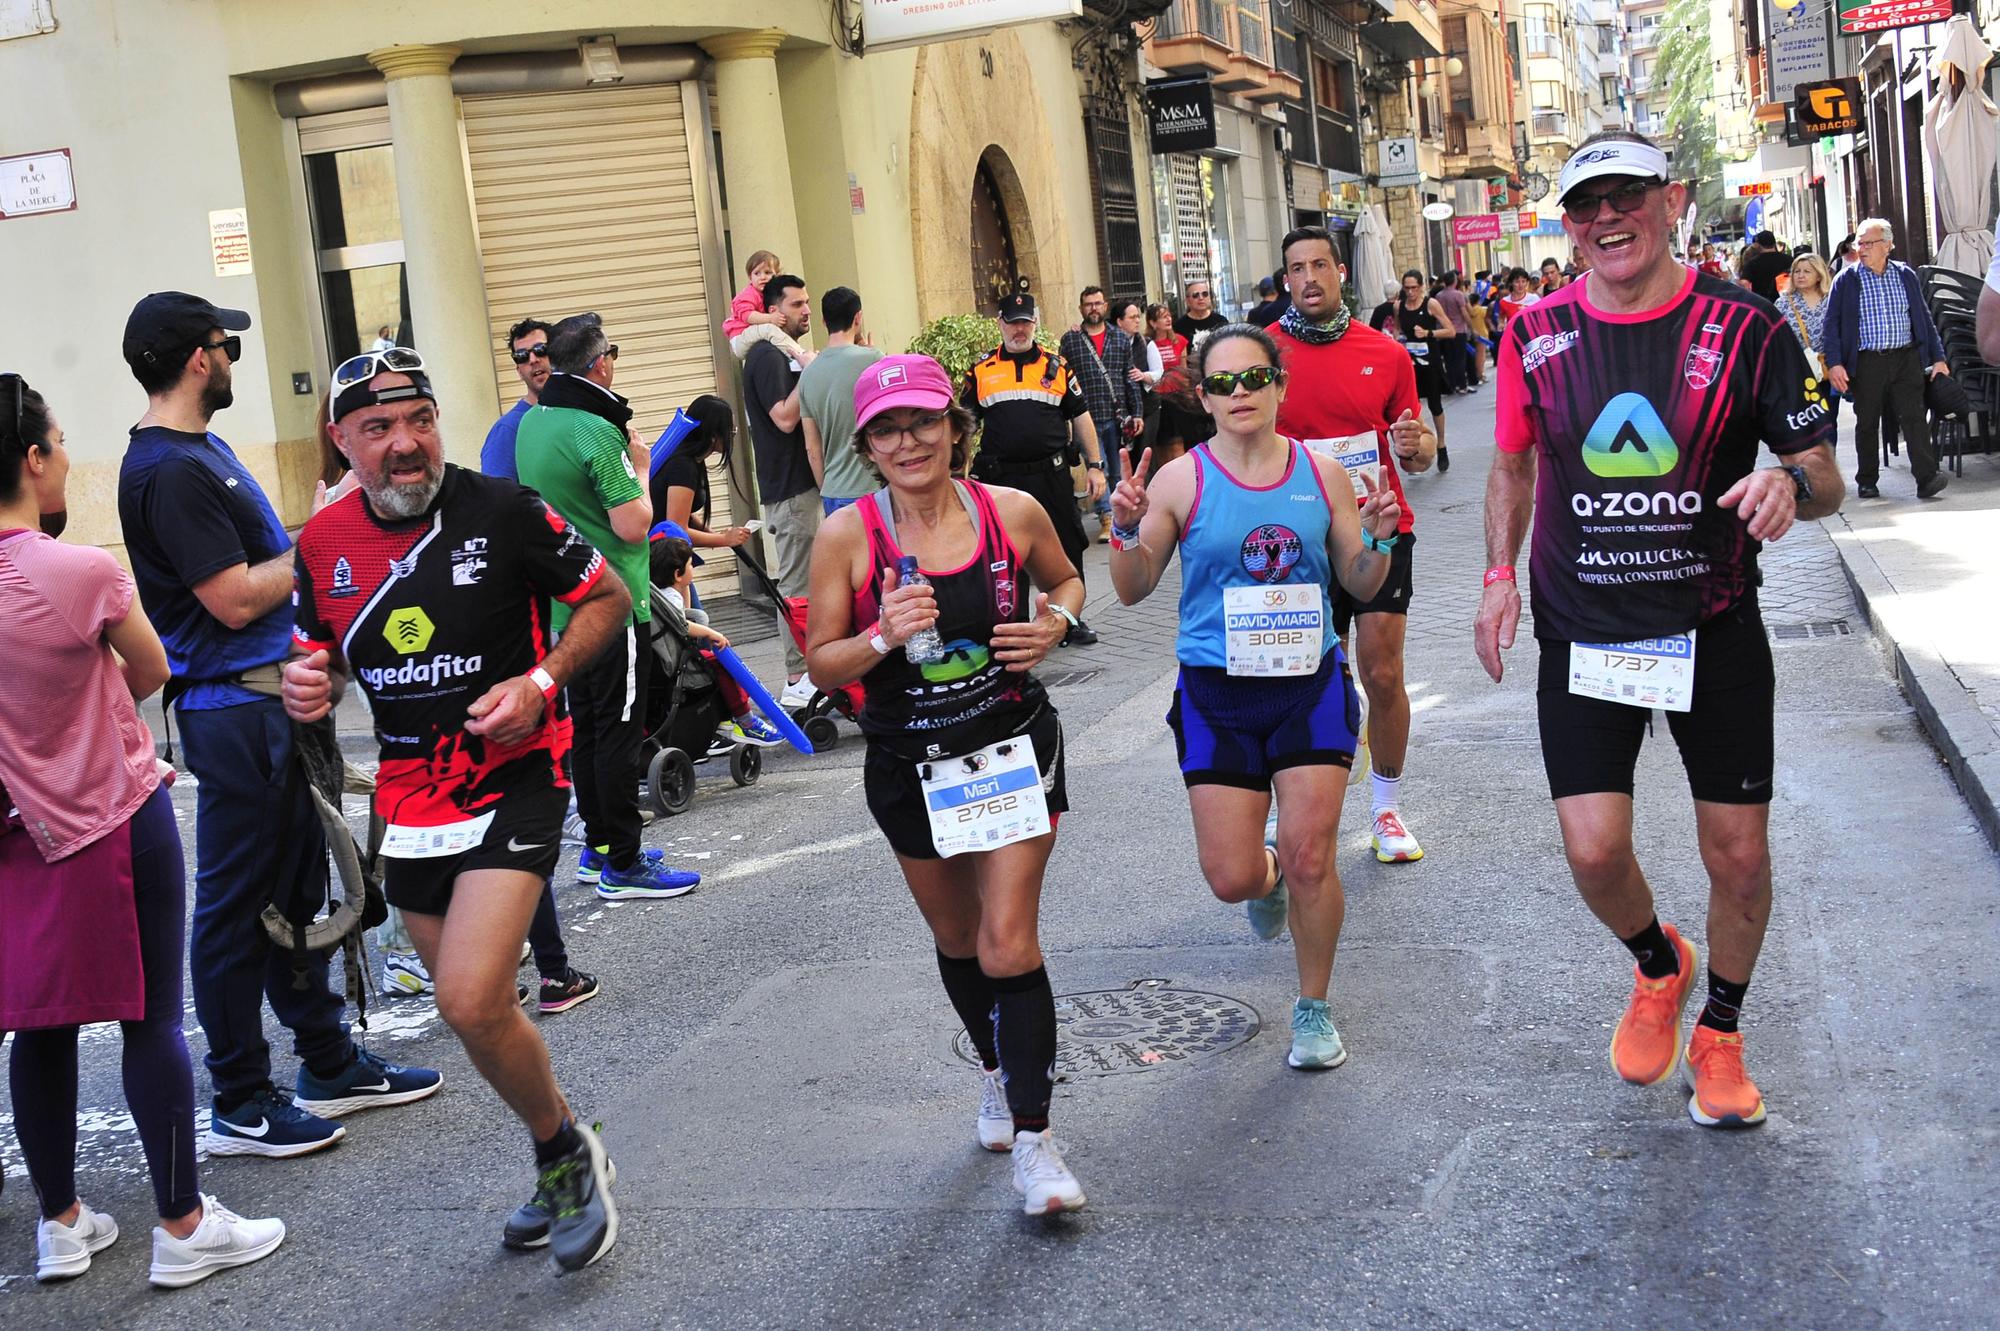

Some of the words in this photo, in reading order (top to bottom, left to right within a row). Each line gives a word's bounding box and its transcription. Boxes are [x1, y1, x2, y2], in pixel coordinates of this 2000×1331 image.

[903, 4, 945, 15] DRESSING
[947, 0, 964, 8] OUR
[1772, 16, 1824, 28] CLNICA
[1774, 23, 1822, 34] DENTAL
[1780, 63, 1822, 73] IMPLANTES
[1775, 84, 1793, 93] 965
[1160, 103, 1201, 121] M&M
[1155, 117, 1208, 129] INTERNATIONAL
[1805, 118, 1858, 132] TABACOS
[20, 173, 46, 184] PLAÇA
[29, 186, 41, 195] DE
[15, 200, 26, 208] LA
[1581, 525, 1592, 533] TU
[1593, 525, 1623, 533] PUNTO
[1638, 523, 1693, 532] ENCUENTRO
[1577, 572, 1624, 585] EMPRESA
[1623, 562, 1712, 583] CONSTRUCTORA
[1228, 612, 1320, 630] DAVIDyMARIO
[1248, 631, 1304, 646] 3082
[1603, 653, 1659, 672] 1737
[963, 777, 1001, 801] Mari
[956, 795, 1019, 823] 2762
